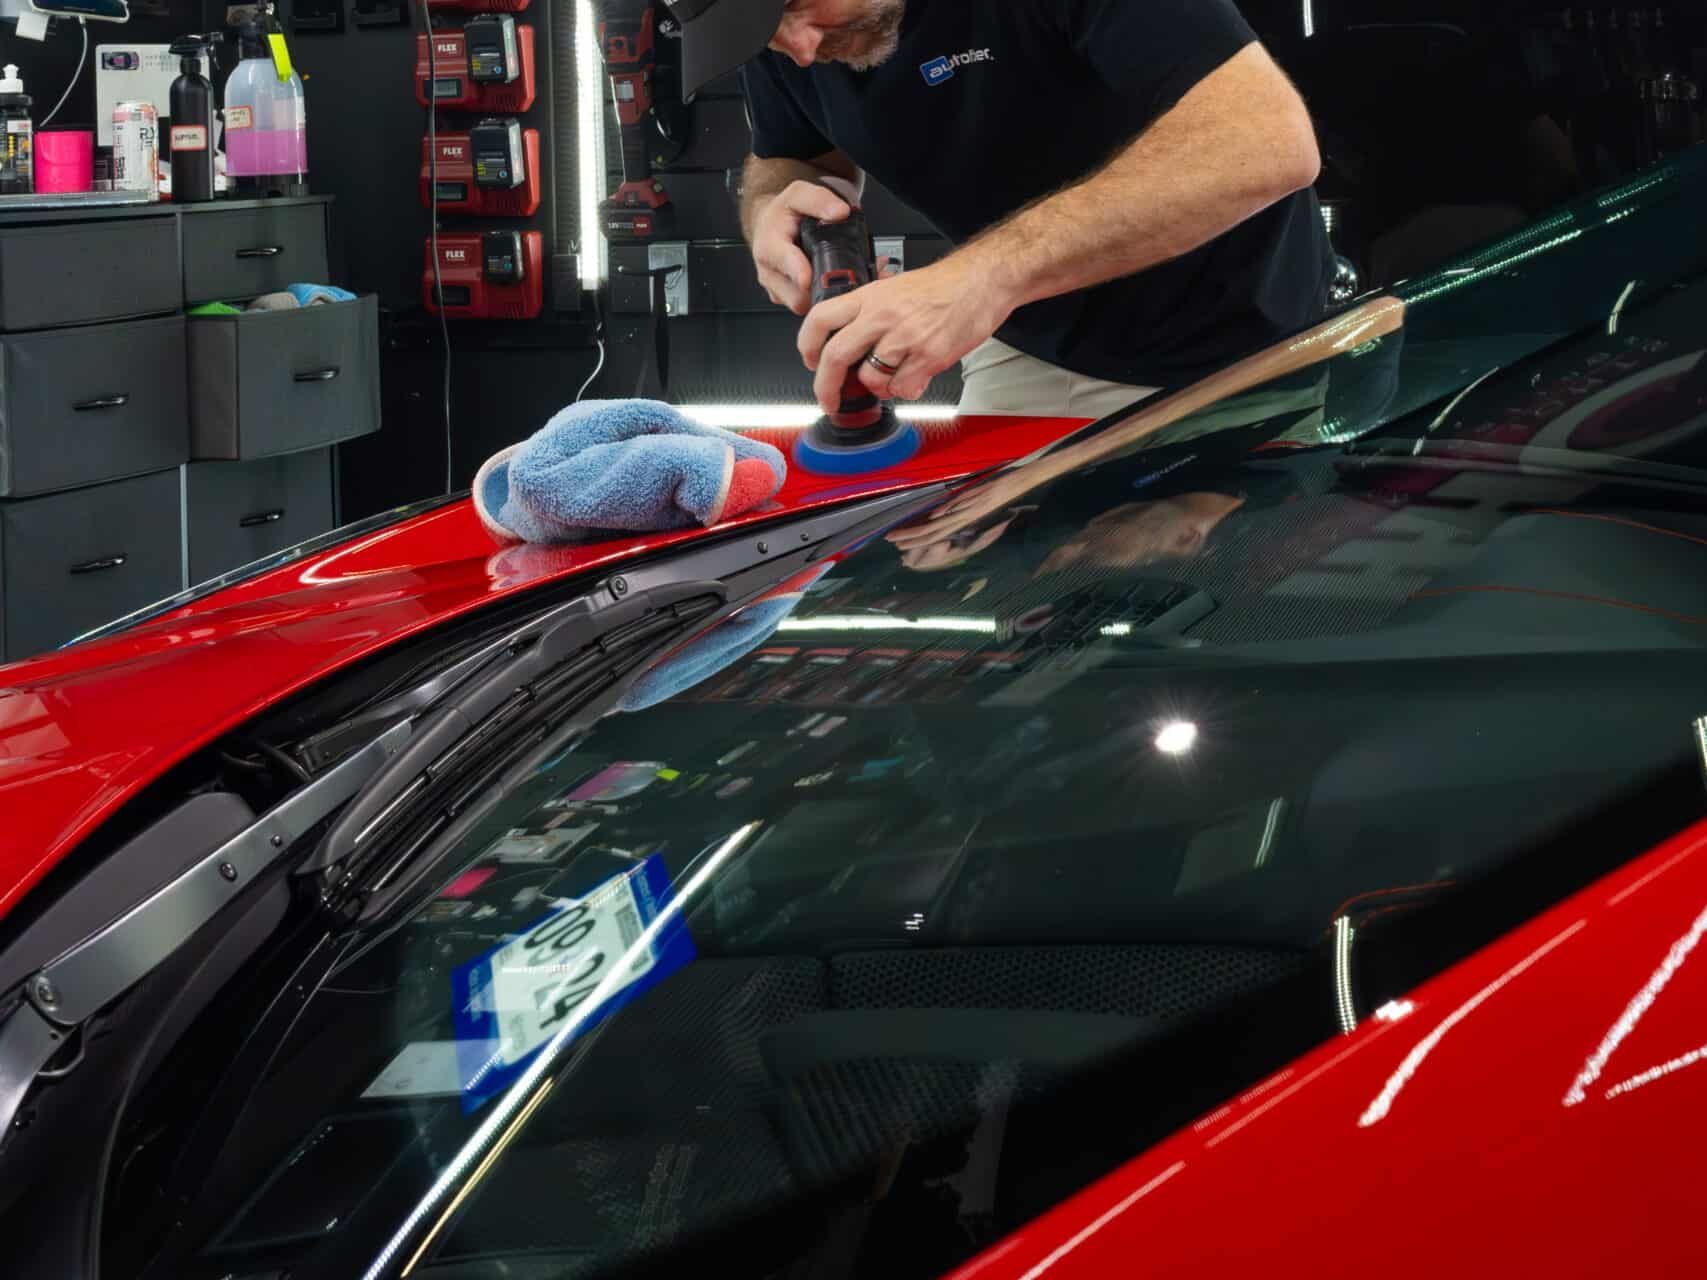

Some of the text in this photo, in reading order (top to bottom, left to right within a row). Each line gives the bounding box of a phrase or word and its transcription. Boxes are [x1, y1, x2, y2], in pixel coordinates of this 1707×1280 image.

[437, 43, 457, 52] FLEX
[442, 147, 463, 155] FLEX
[445, 250, 466, 259] FLEX
